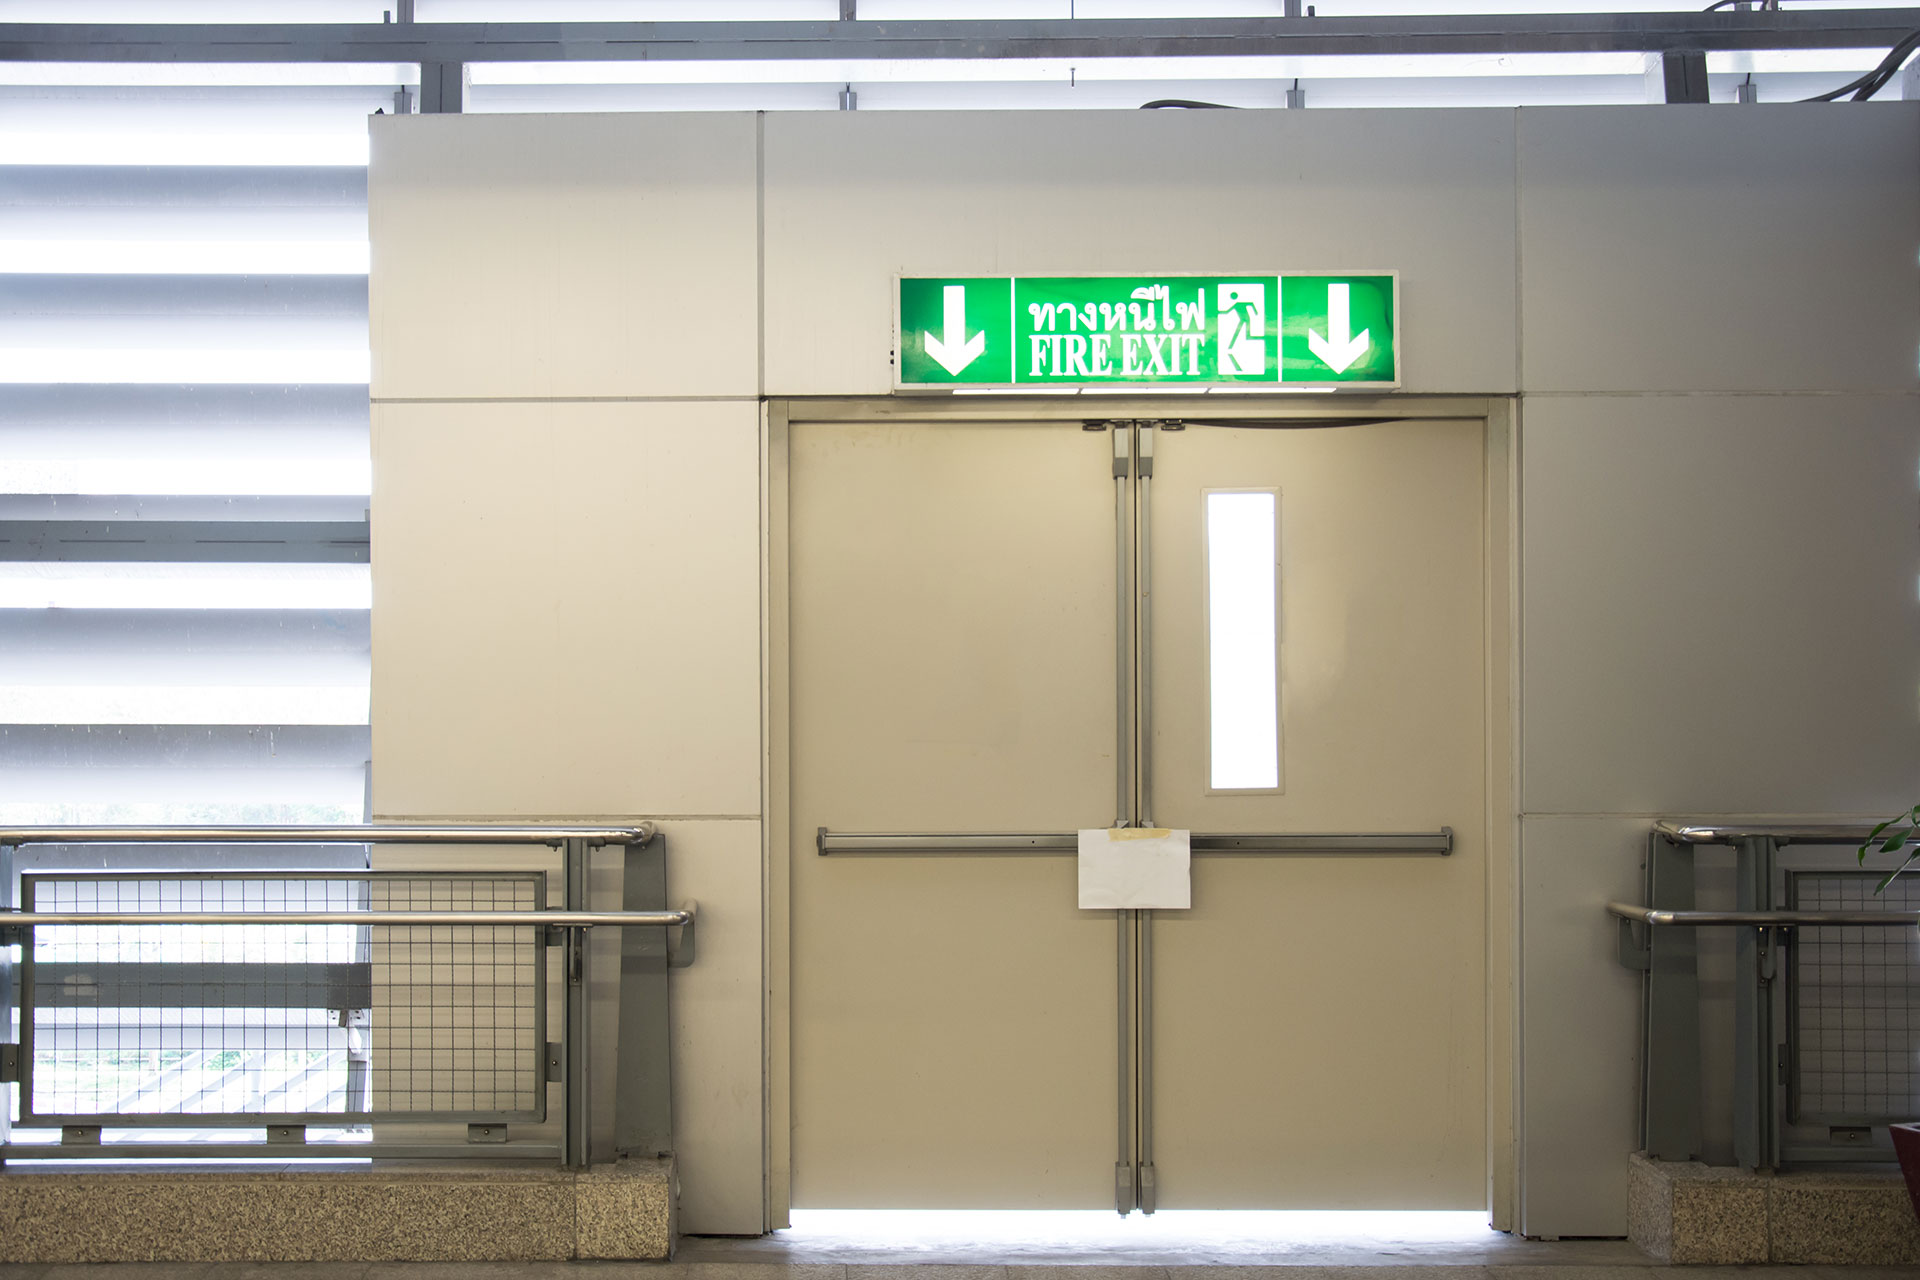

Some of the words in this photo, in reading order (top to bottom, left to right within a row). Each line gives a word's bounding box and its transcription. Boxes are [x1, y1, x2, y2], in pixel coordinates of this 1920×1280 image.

[1028, 284, 1205, 331] ทางหนีไฟ
[1029, 334, 1113, 377] FIRE
[1119, 333, 1205, 376] EXIT
